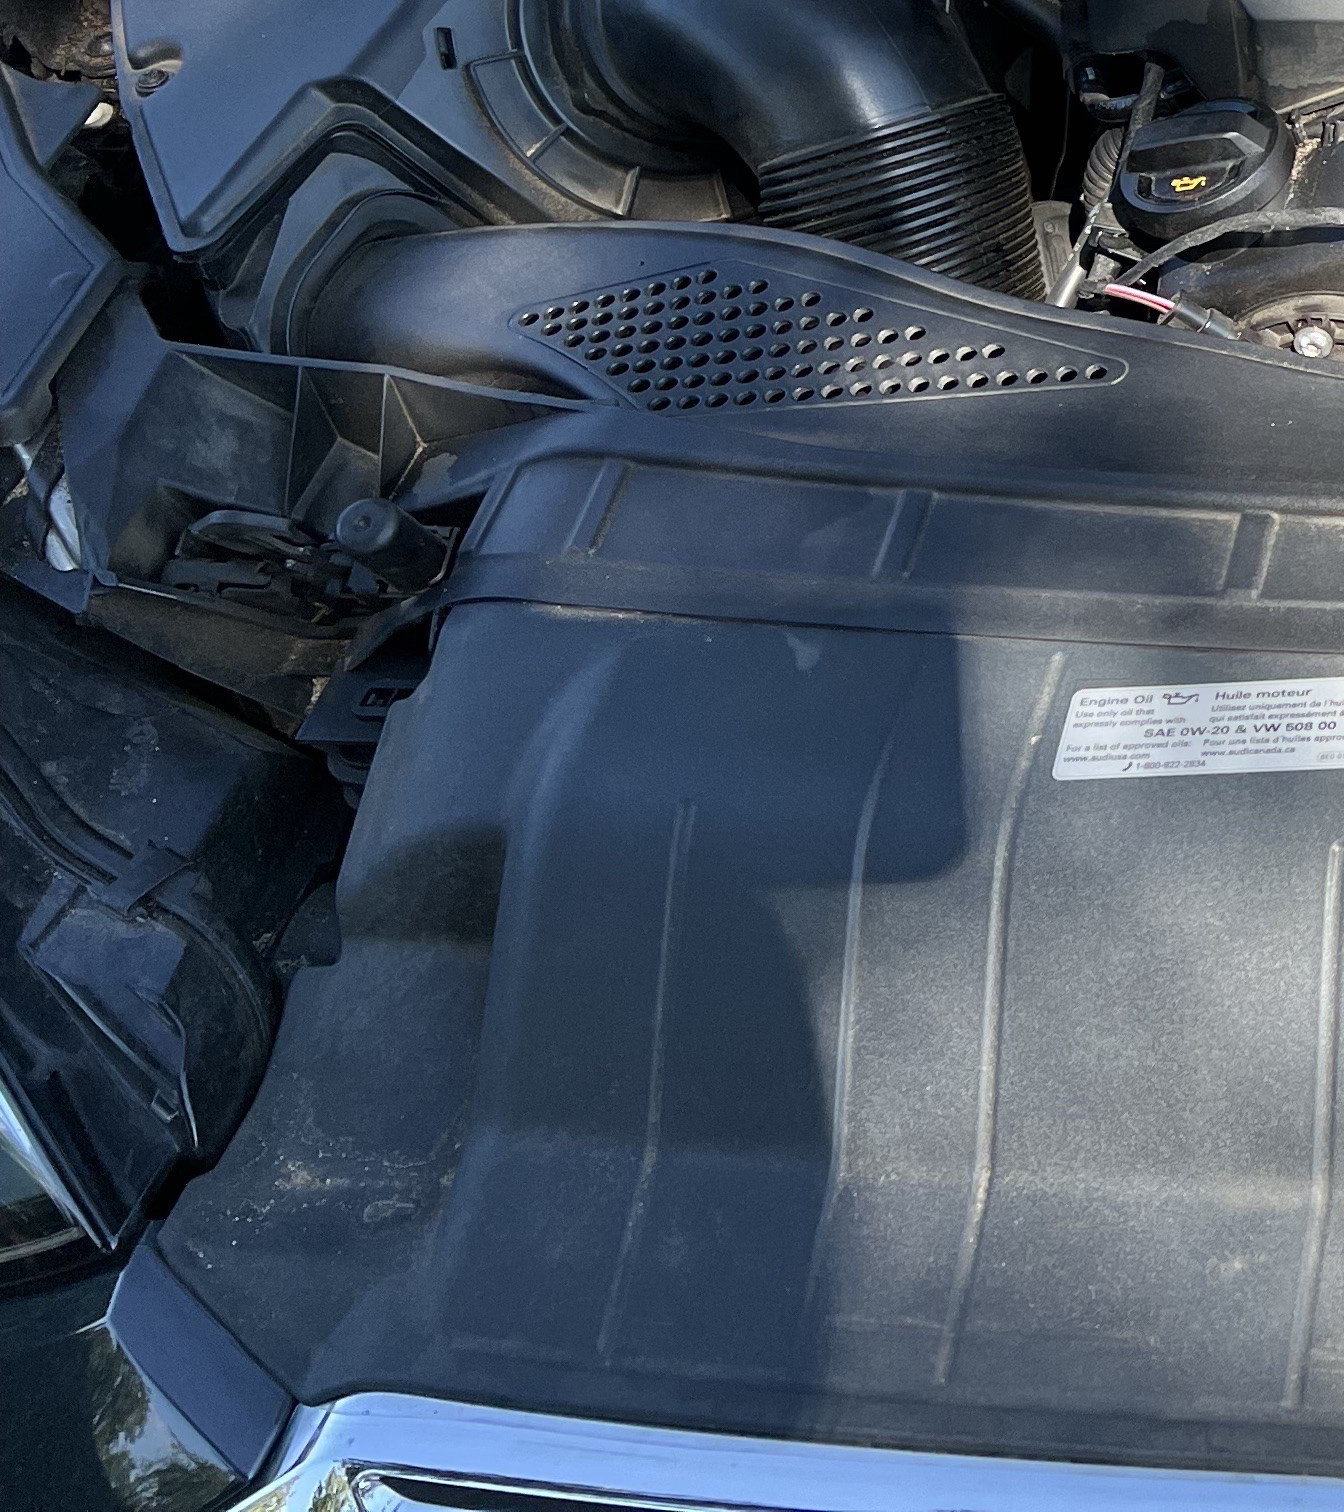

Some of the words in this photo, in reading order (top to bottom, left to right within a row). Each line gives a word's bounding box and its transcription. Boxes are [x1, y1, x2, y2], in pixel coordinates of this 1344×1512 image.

[1215, 691, 1252, 701] Huile
[1256, 688, 1312, 699] moteur
[1080, 697, 1128, 709] Engine
[1134, 694, 1153, 704] Oil
[1249, 701, 1307, 711] uniquement
[1310, 700, 1322, 708] de
[1075, 710, 1094, 718] Use
[1097, 709, 1118, 717] only
[1209, 714, 1225, 723] qui
[1073, 720, 1116, 729] expressly
[1120, 718, 1162, 727] complies
[1144, 725, 1176, 738] SAE
[1181, 725, 1230, 736] 0W-20
[1236, 725, 1248, 734] &
[1253, 723, 1280, 733] VW
[1286, 722, 1313, 732] 508
[1319, 721, 1337, 731] 00
[1123, 740, 1169, 752] approved
